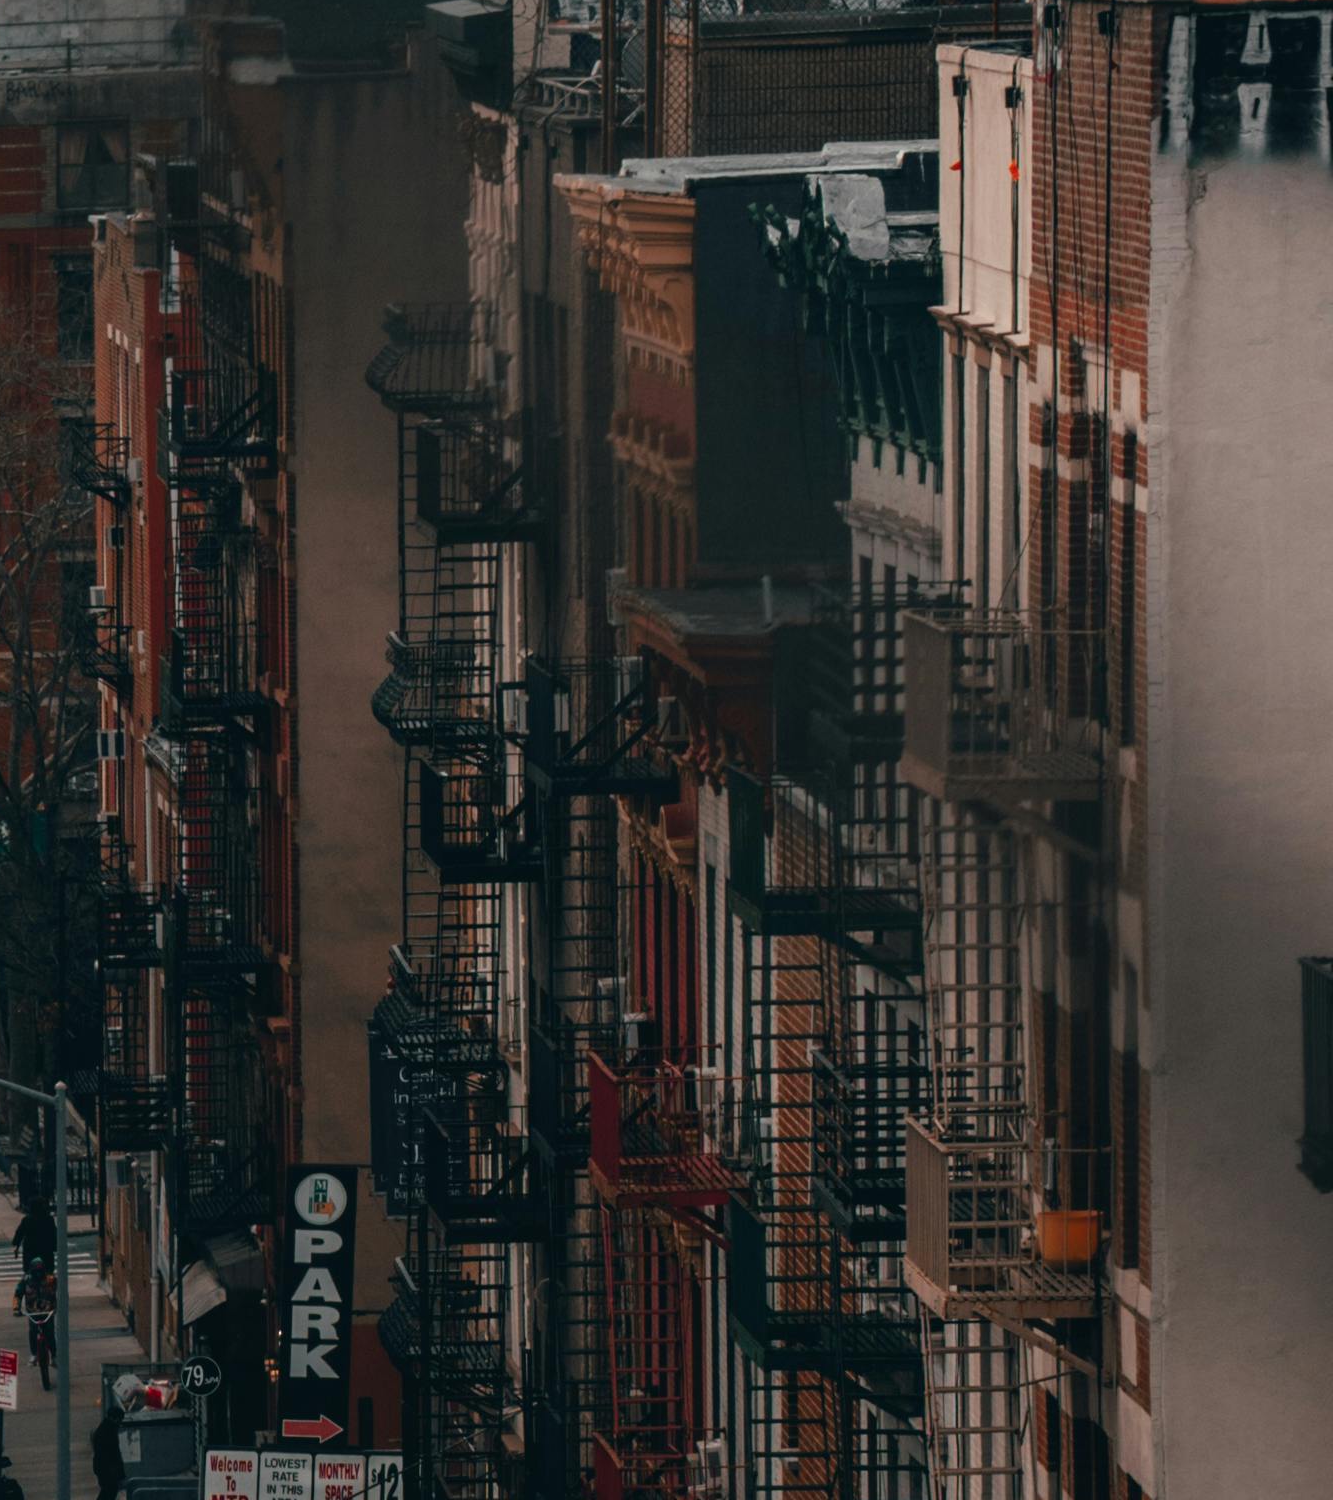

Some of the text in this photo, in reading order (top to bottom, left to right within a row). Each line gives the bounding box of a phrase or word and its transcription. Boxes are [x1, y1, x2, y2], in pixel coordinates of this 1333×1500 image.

[289, 1229, 343, 1379] PARK
[183, 1364, 205, 1388] 79
[210, 1455, 253, 1473] Welcome
[264, 1457, 307, 1469] LOWEST
[318, 1462, 360, 1480] MONTHLY
[226, 1475, 236, 1491] To
[272, 1471, 299, 1482] RATE
[267, 1484, 303, 1495] IN THIS
[325, 1485, 353, 1500] SPACE
